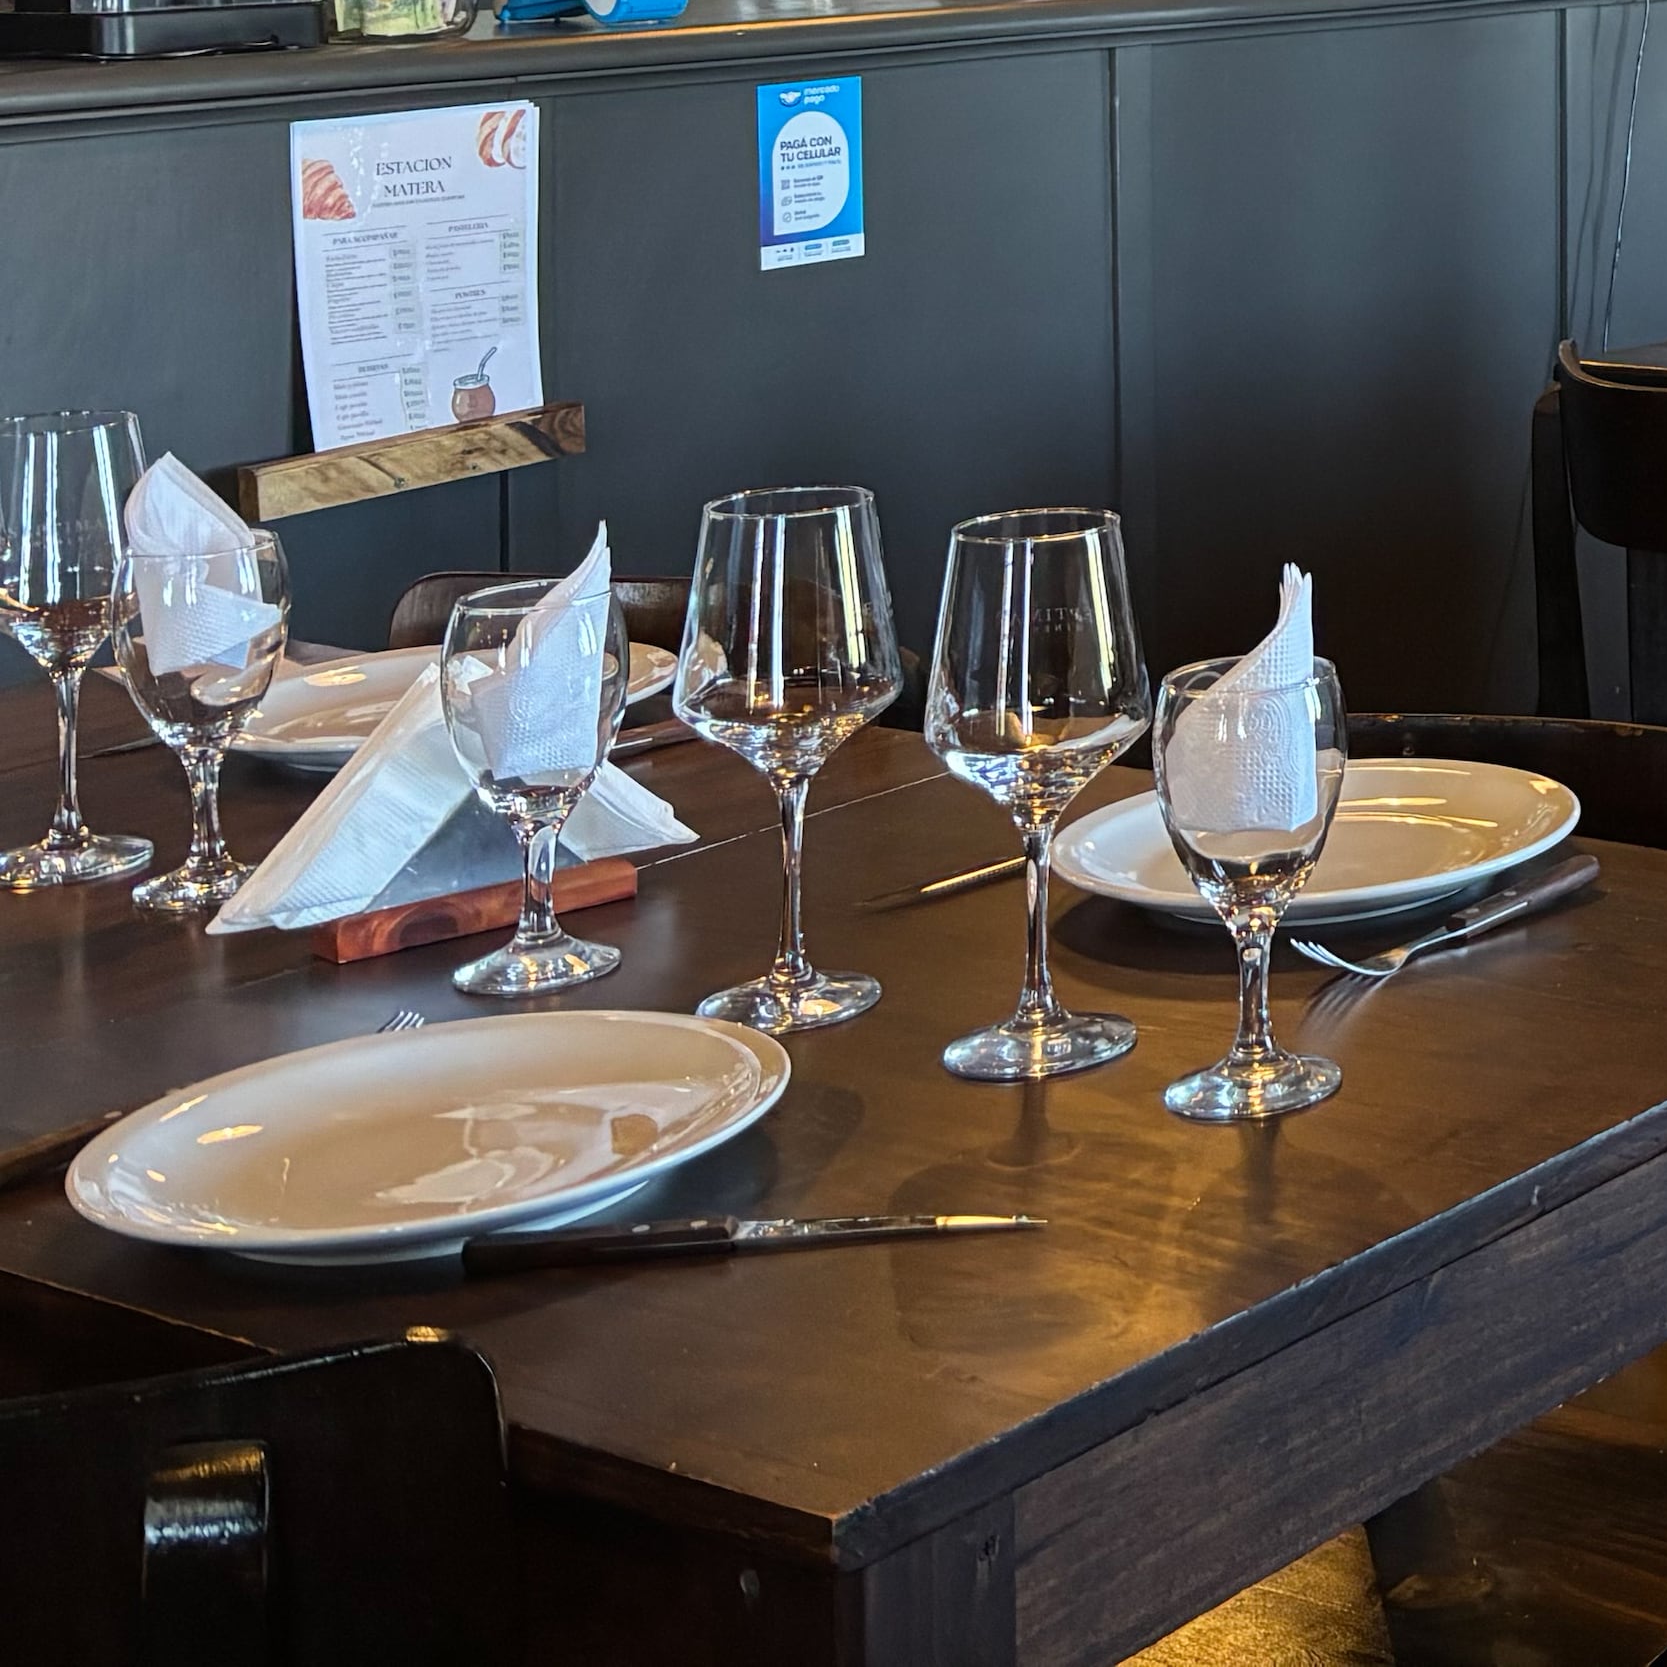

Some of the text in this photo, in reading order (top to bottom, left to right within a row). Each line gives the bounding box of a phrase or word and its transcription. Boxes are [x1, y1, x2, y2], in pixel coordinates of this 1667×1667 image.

[804, 84, 840, 96] mercado
[804, 95, 825, 105] pago
[810, 135, 832, 147] CON
[780, 146, 841, 163] TU CELULAR
[376, 156, 453, 176] ESTACION
[384, 179, 446, 198] MATERA
